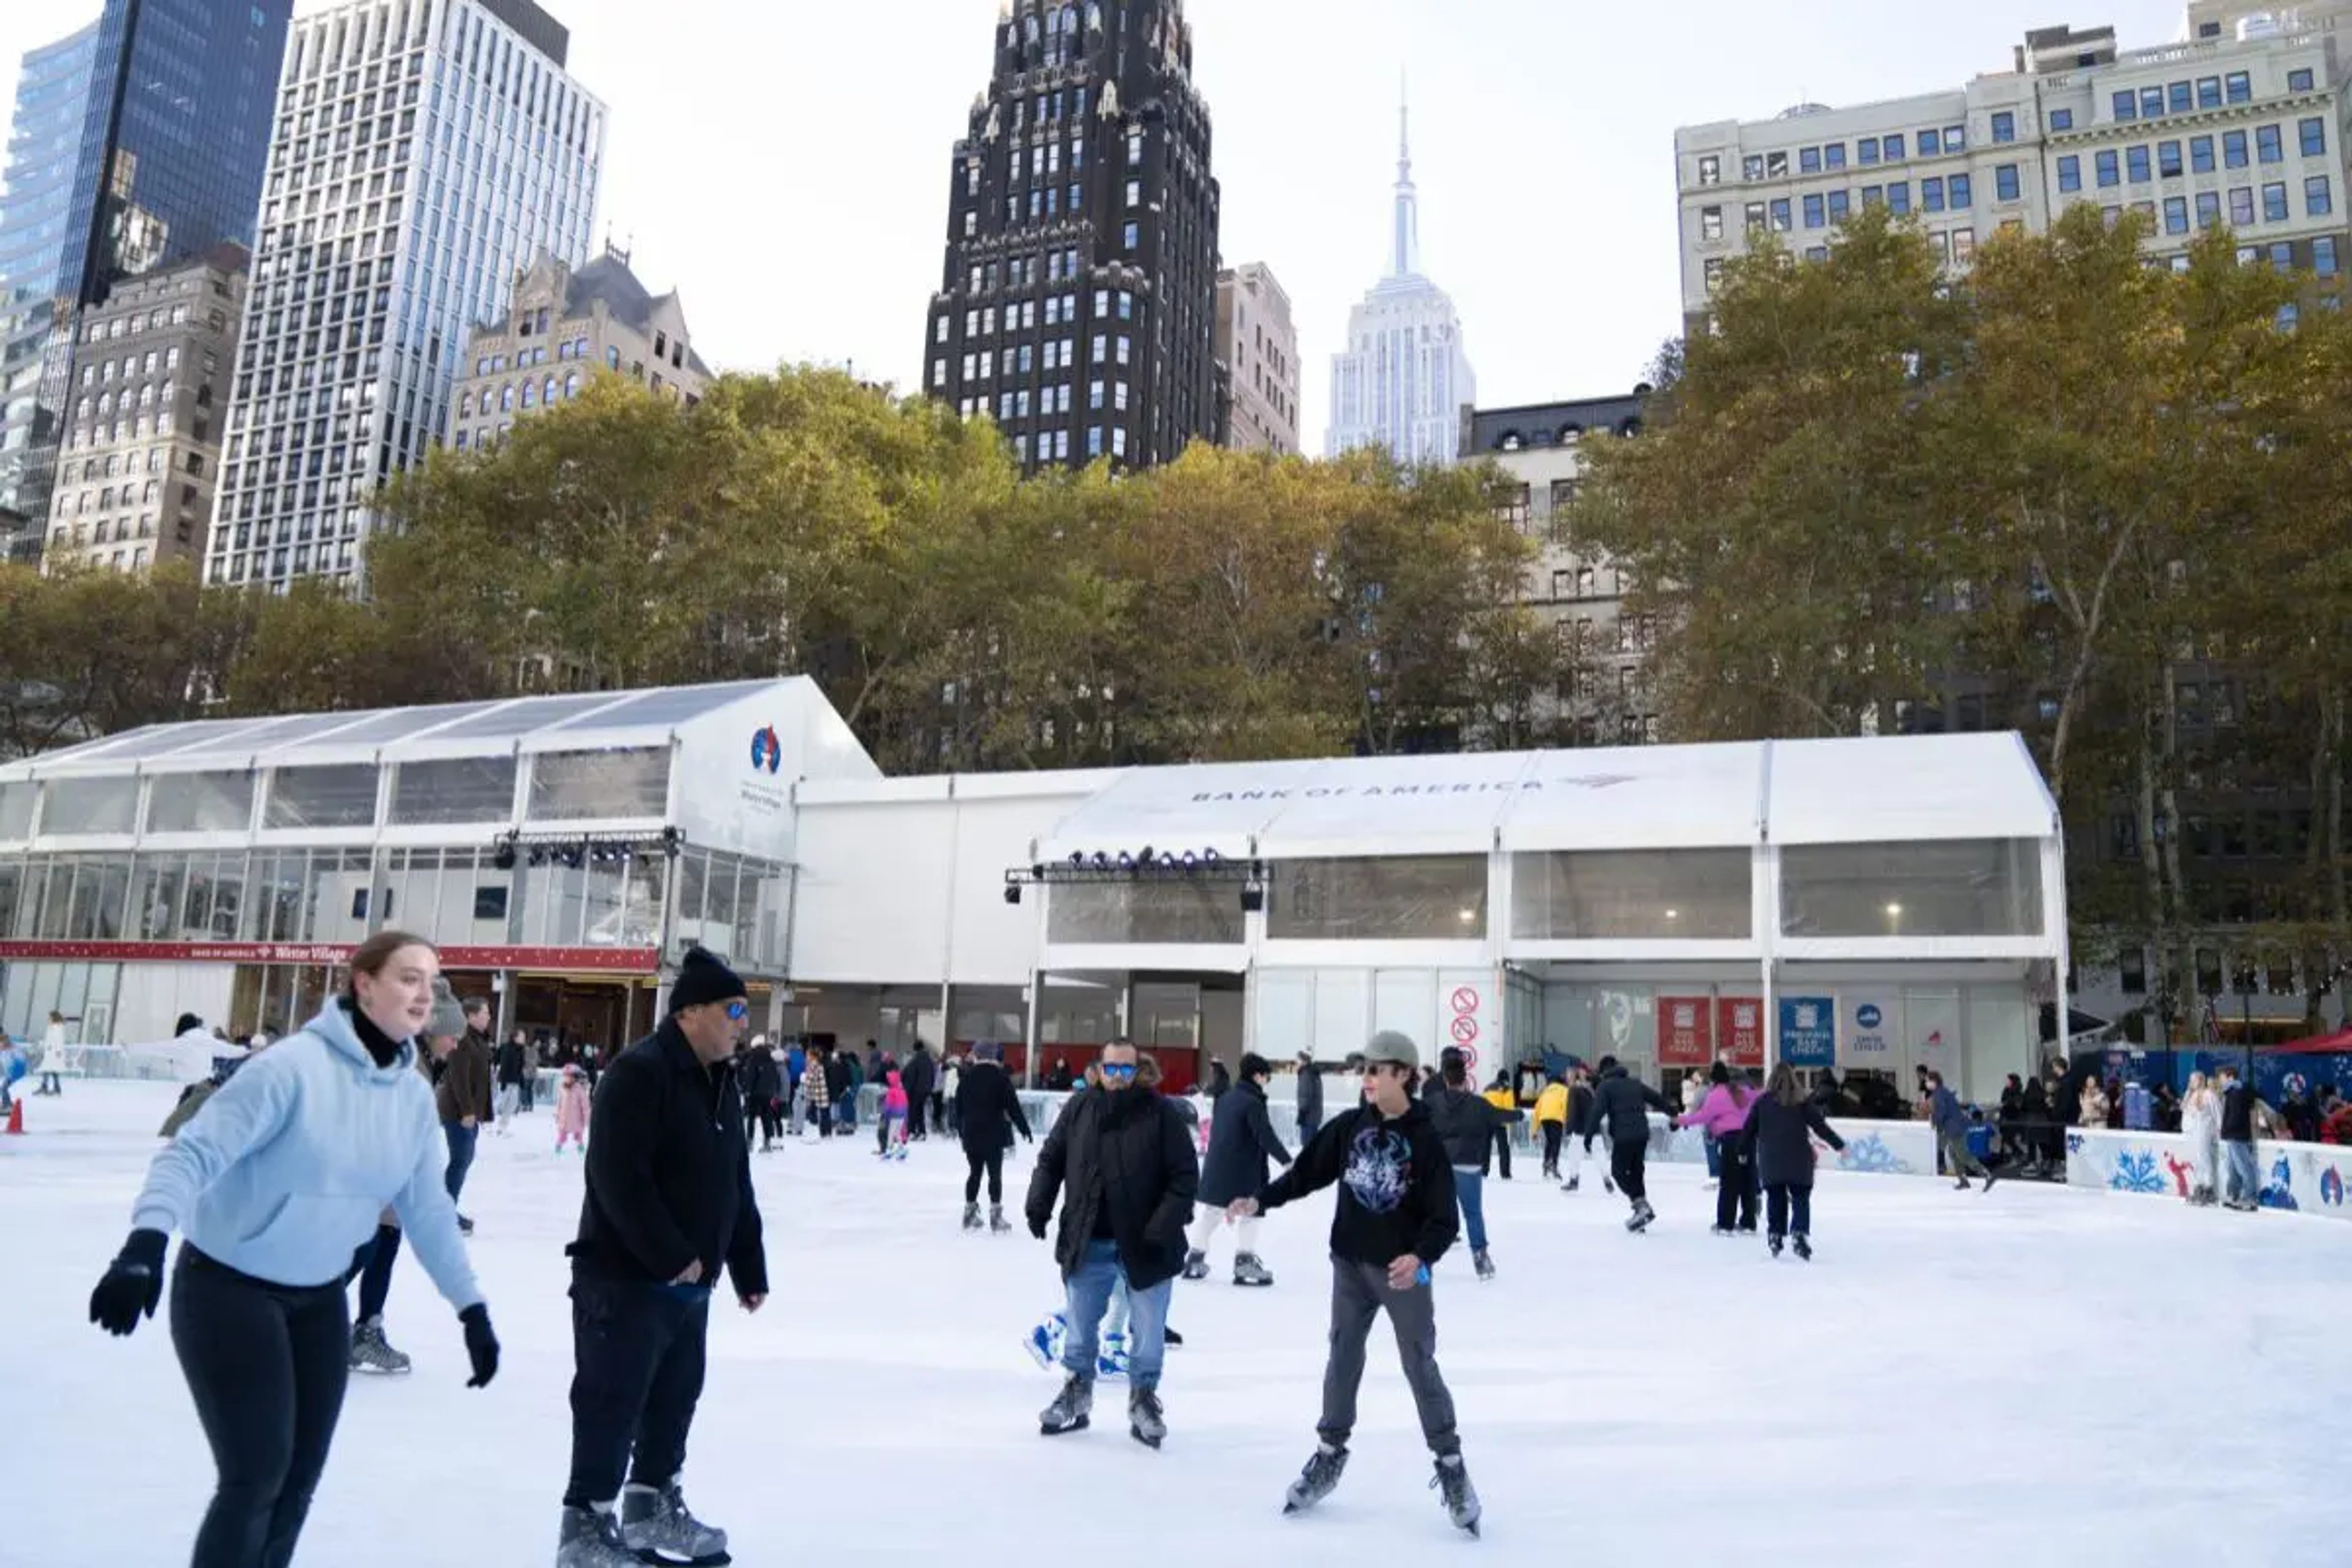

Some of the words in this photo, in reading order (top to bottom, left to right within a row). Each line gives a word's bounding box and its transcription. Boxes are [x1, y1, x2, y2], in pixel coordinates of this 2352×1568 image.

[1192, 786, 1292, 802] BANK
[1305, 784, 1354, 798] OF
[1362, 780, 1543, 796] AMERICA
[275, 946, 309, 959] Winter
[312, 946, 347, 964] Village
